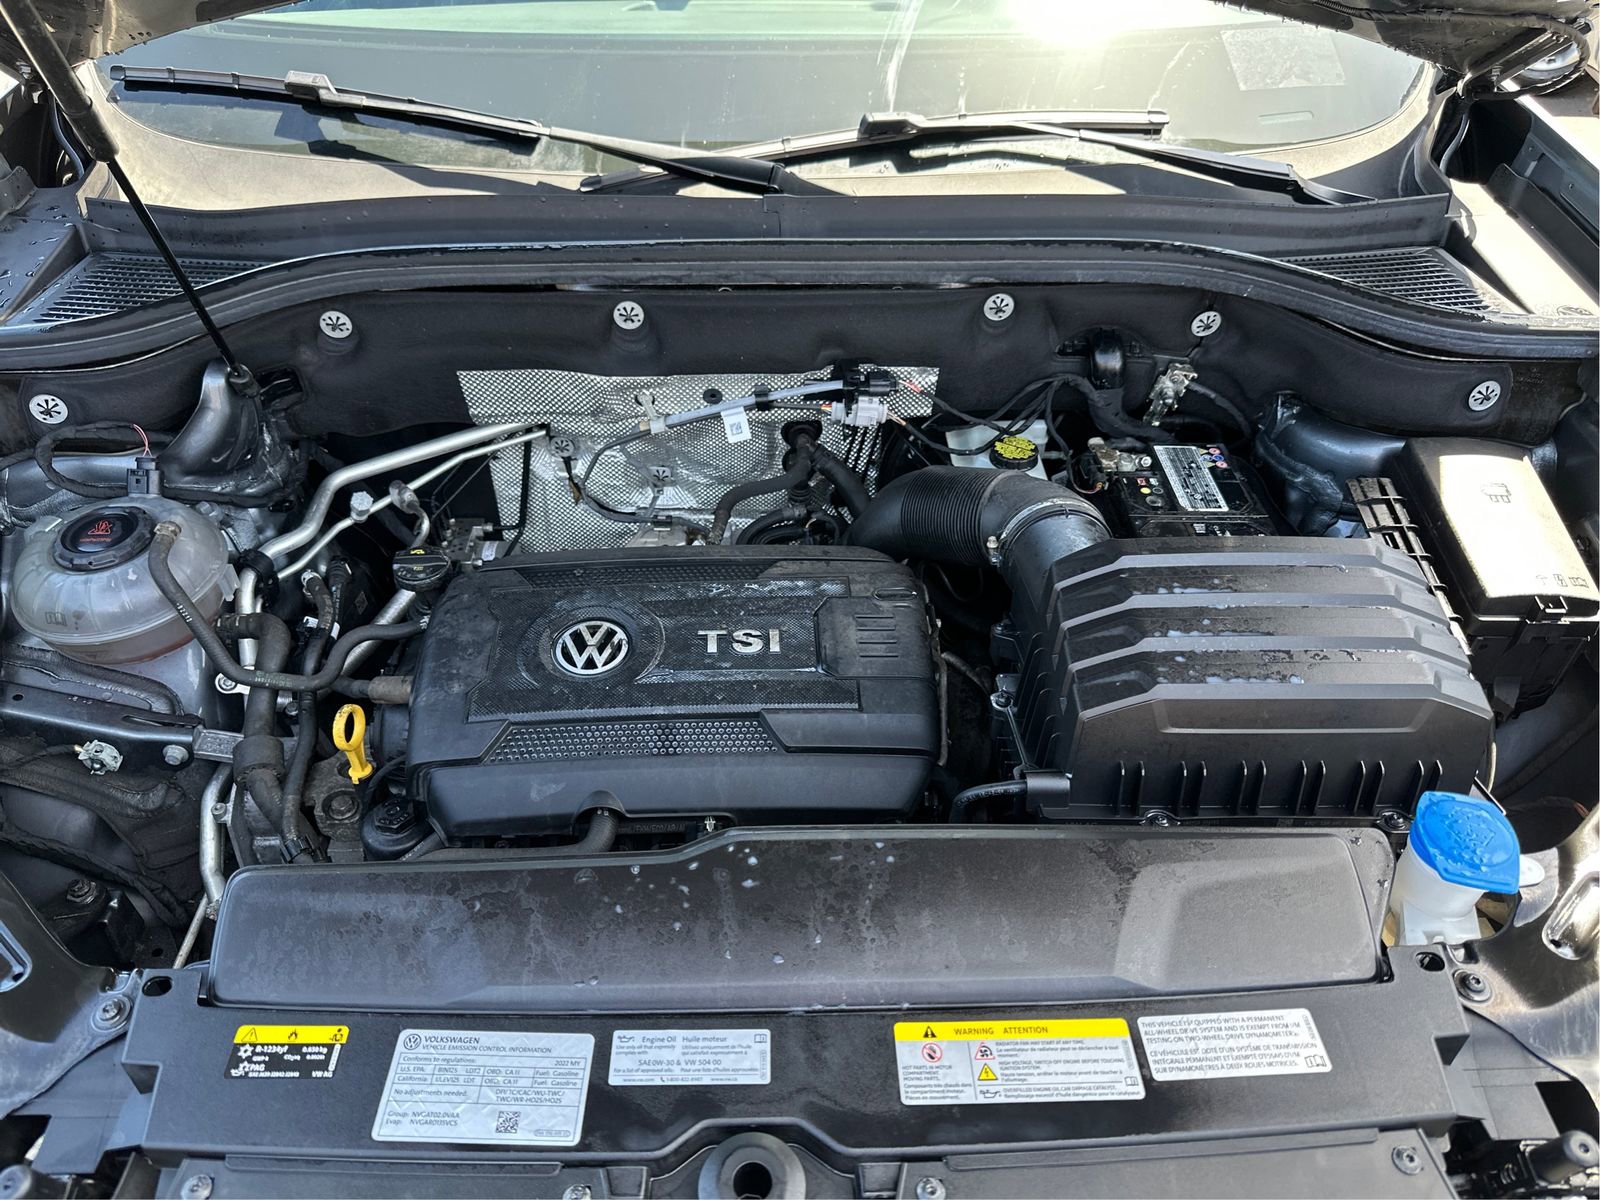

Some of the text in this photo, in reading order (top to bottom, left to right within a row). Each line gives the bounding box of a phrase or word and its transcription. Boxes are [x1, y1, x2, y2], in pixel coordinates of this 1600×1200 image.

[698, 628, 781, 654] TSI
[954, 1026, 1048, 1035] WARNING ATTENTION
[424, 1035, 480, 1044] VOLKSWAGEN
[642, 1036, 665, 1044] Engine
[1185, 1033, 1224, 1041] TWO-WHEEL
[404, 1088, 442, 1096] adjustments
